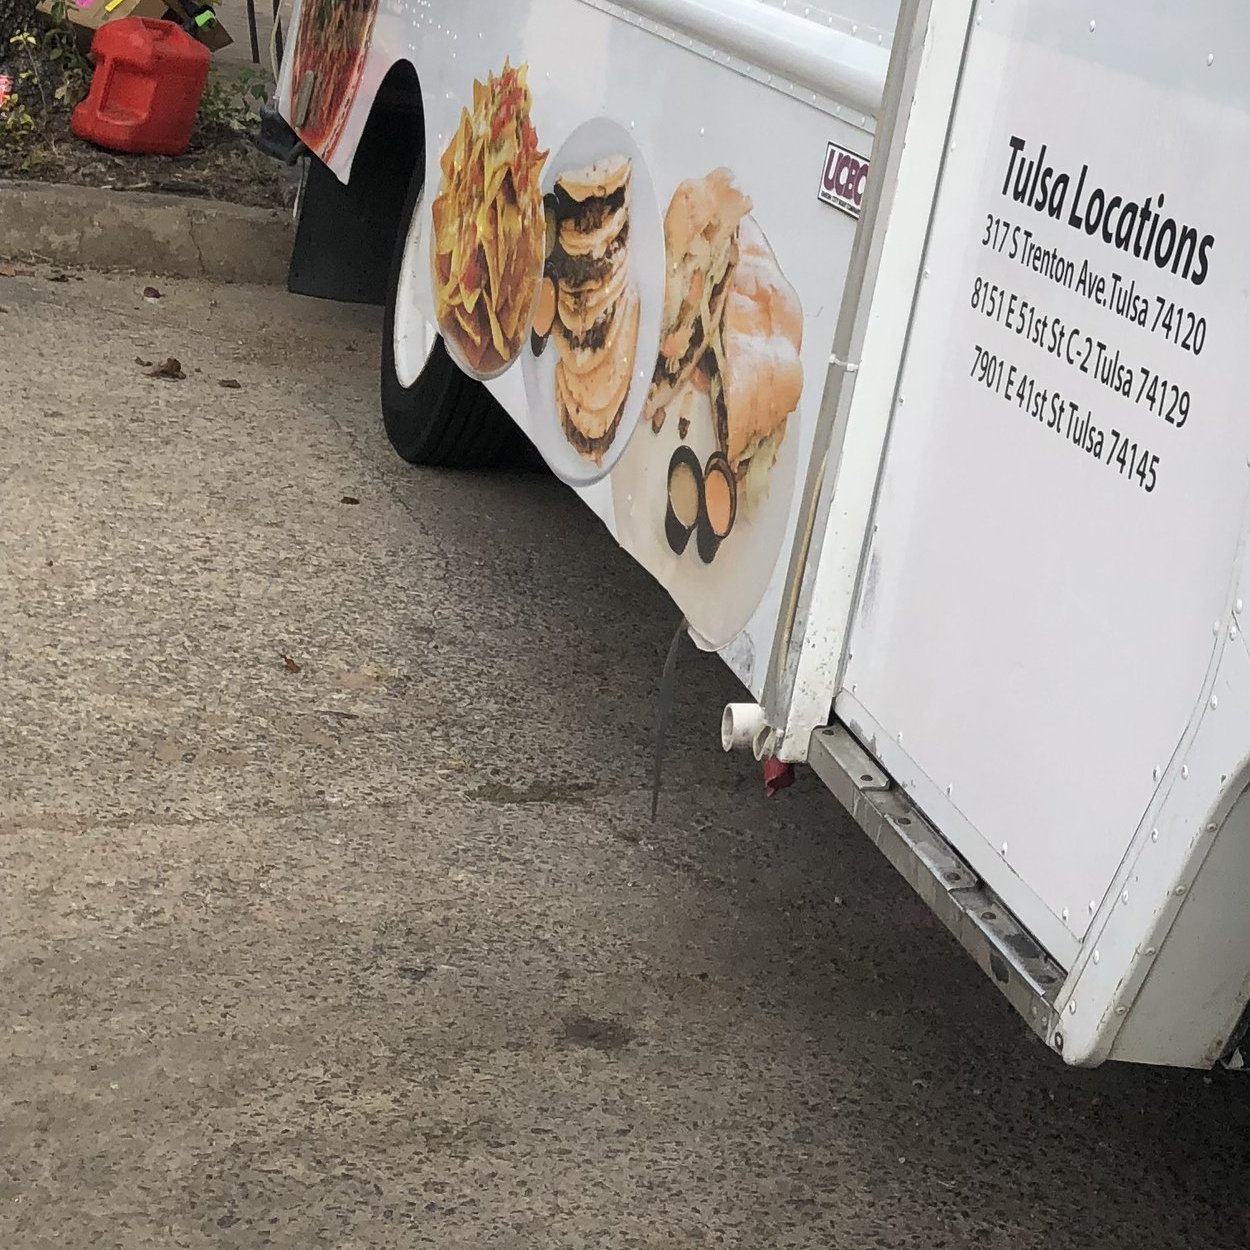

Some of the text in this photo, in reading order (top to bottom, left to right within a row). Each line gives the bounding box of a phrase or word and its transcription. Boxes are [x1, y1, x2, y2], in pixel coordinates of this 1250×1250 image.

[981, 213, 1011, 252] 317
[1009, 225, 1021, 259] S
[1020, 229, 1075, 289] Trenton
[1150, 295, 1207, 356] 74120
[1002, 135, 1215, 286] Tulsa Locations
[970, 344, 1160, 493] 7901 E 41st St Tulsa 74145
[971, 276, 1191, 428] 8151 E 51st St C-2 Tulsa 74129
